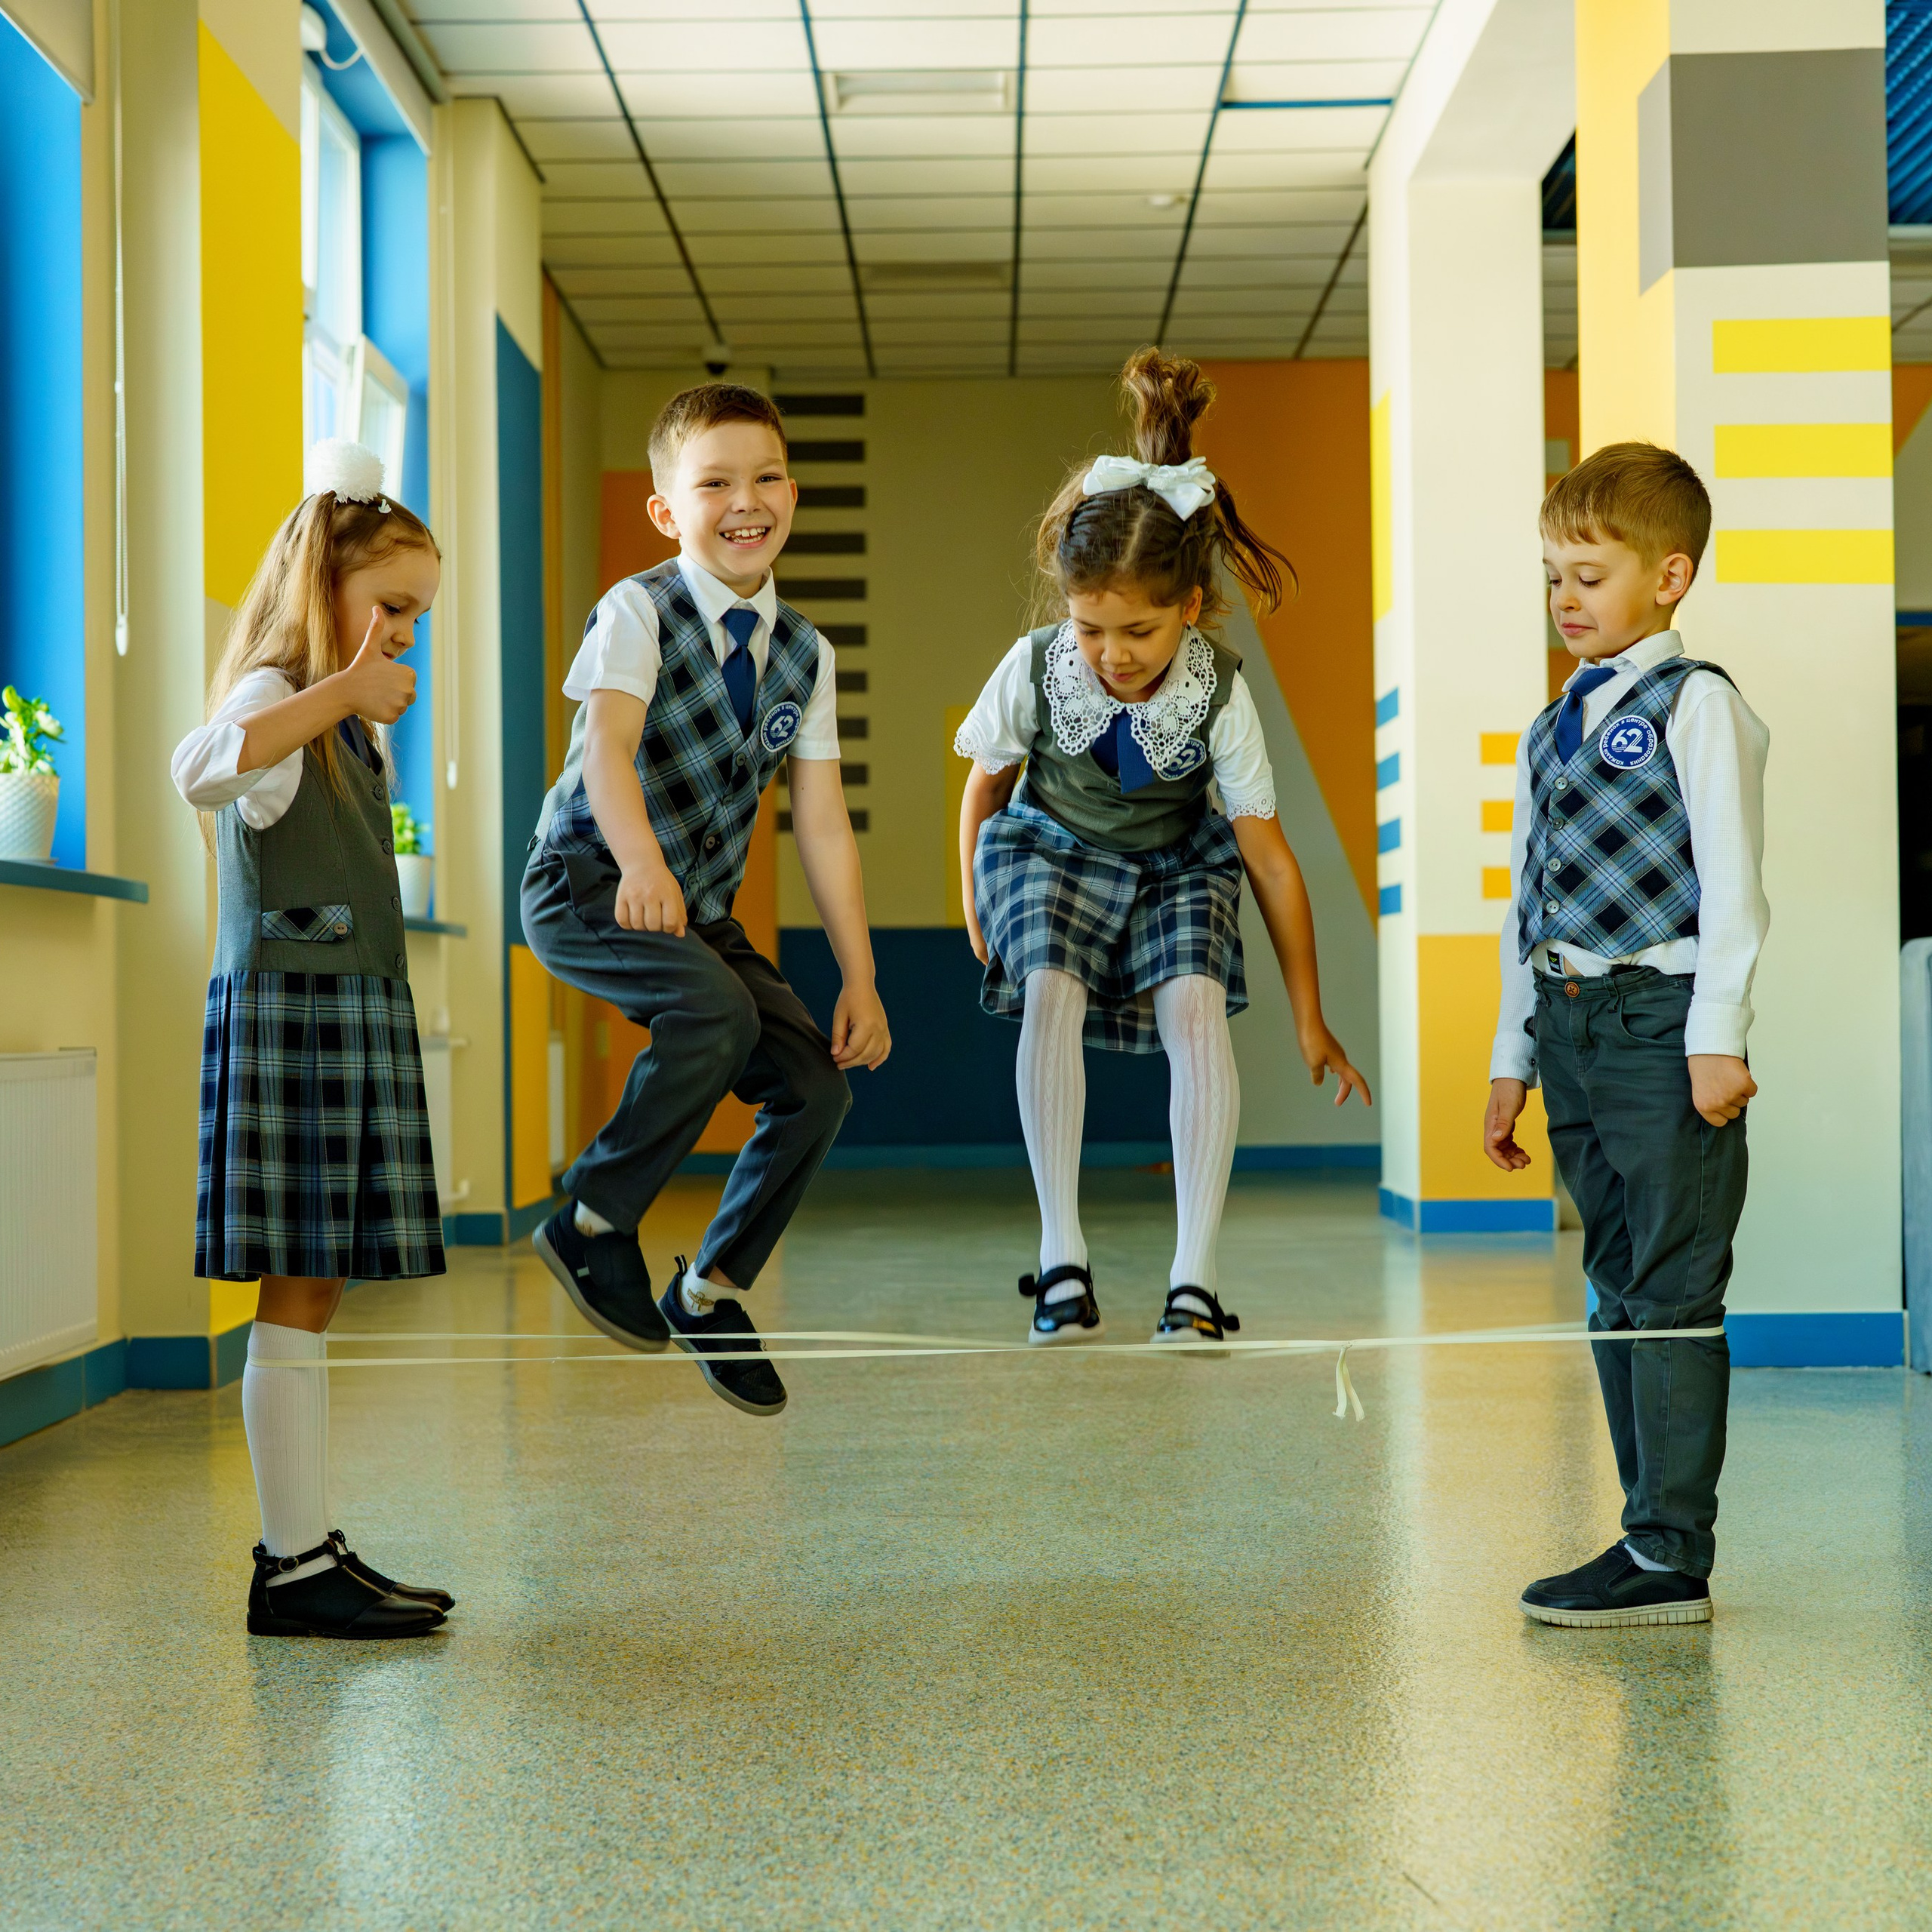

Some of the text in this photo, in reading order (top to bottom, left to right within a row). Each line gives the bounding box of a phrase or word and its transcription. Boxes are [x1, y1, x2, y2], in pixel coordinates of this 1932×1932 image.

[770, 715, 794, 738] 62
[1603, 723, 1620, 748] ребенок
[1626, 718, 1648, 729] центре
[1611, 728, 1644, 753] 62
[1629, 730, 1654, 765] образования
[1168, 748, 1196, 771] 62
